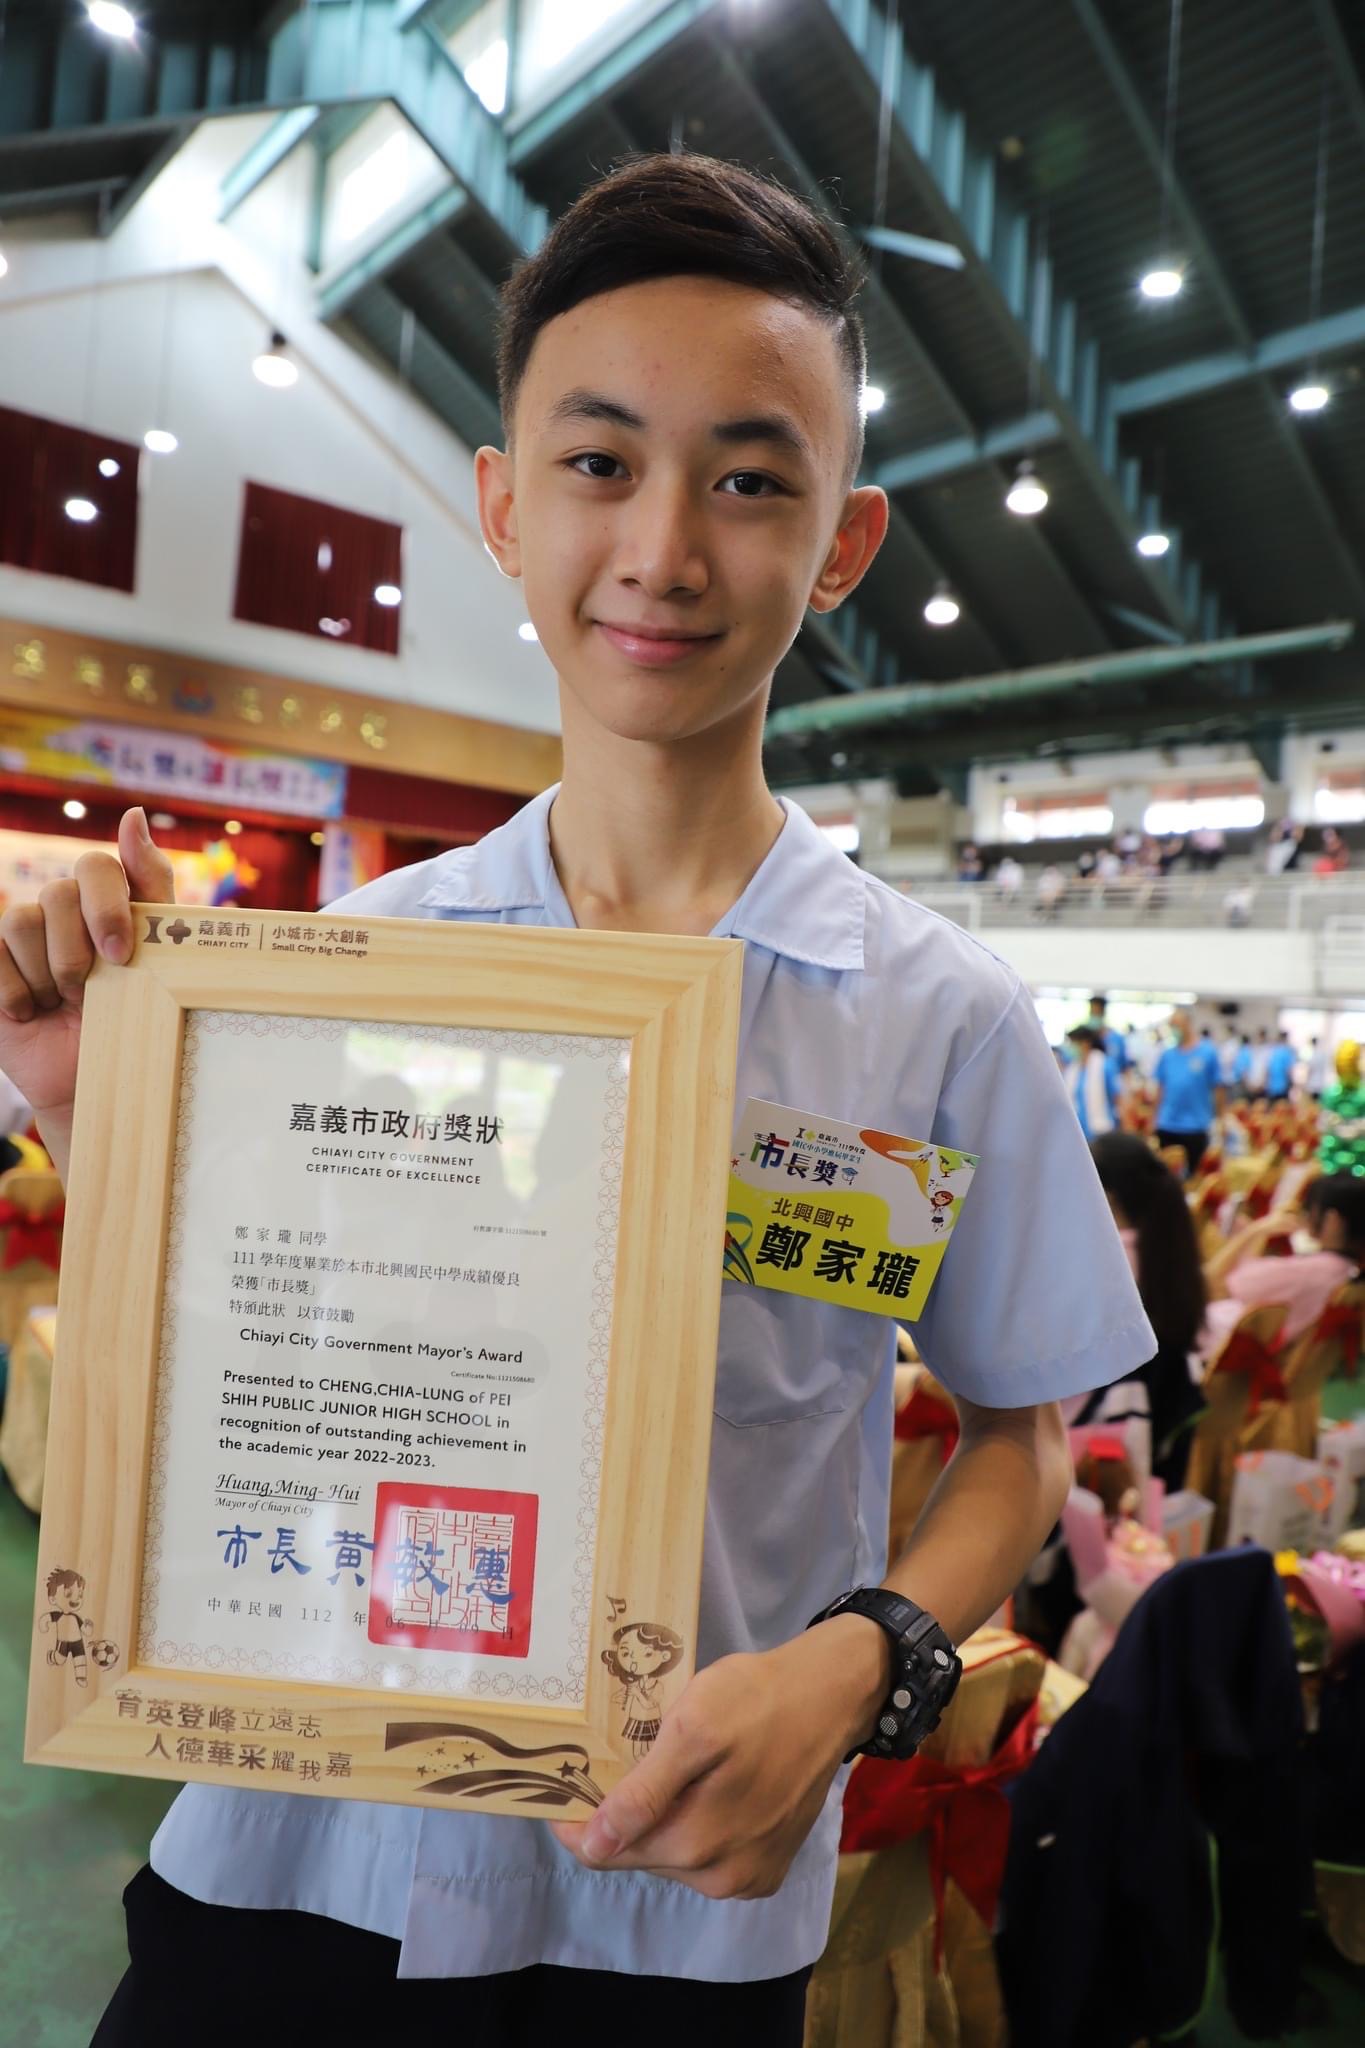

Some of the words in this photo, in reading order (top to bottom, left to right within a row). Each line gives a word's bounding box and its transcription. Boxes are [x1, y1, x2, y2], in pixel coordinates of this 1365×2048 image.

[198, 919, 252, 938] 嘉義市
[198, 939, 227, 948] CHIAYI
[230, 941, 249, 949] CITY
[272, 943, 295, 952] Small
[297, 944, 316, 955] City
[318, 946, 332, 956] Big
[335, 947, 368, 957] Change
[289, 1102, 505, 1144] 嘉義市政府獎狀
[312, 1147, 352, 1158] CHIAYI
[357, 1150, 385, 1160] CITY
[390, 1152, 474, 1167] GOVERNMENT
[750, 1133, 839, 1186] 市長獎
[306, 1163, 381, 1177] CERTIFICATE
[387, 1169, 402, 1178] OF
[407, 1171, 481, 1184] EXCELLENCE
[771, 1198, 855, 1232] 北興國中
[755, 1222, 920, 1299] 鄭家瓏
[239, 1328, 285, 1345] Chiayi
[289, 1333, 319, 1350] City
[324, 1336, 413, 1354] Government
[418, 1343, 473, 1360] Mayor's
[478, 1349, 522, 1363] Award
[224, 1370, 294, 1388] Presented
[299, 1377, 314, 1389] to
[469, 1391, 486, 1403] of
[490, 1393, 510, 1406] PEI
[222, 1392, 258, 1406] SHIH
[262, 1395, 315, 1411] PUBLIC
[319, 1401, 377, 1417] JUNIOR
[383, 1407, 421, 1421] HIGH
[426, 1410, 492, 1427] SCHOOL
[497, 1416, 509, 1428] in
[220, 1414, 301, 1433] recognition
[306, 1421, 321, 1434] of
[326, 1424, 412, 1446] outstanding
[417, 1432, 508, 1451] achievement
[514, 1440, 526, 1453] in
[219, 1437, 242, 1450] the
[247, 1439, 313, 1457] academic
[318, 1448, 349, 1461] year
[354, 1449, 436, 1468] 2022-2023.
[215, 1497, 246, 1510] Mayor
[249, 1500, 259, 1511] of
[261, 1501, 290, 1515] Chiayi
[293, 1504, 313, 1518] City
[328, 1484, 362, 1501] Hui
[300, 1608, 332, 1623] 112
[353, 1611, 367, 1626] 年
